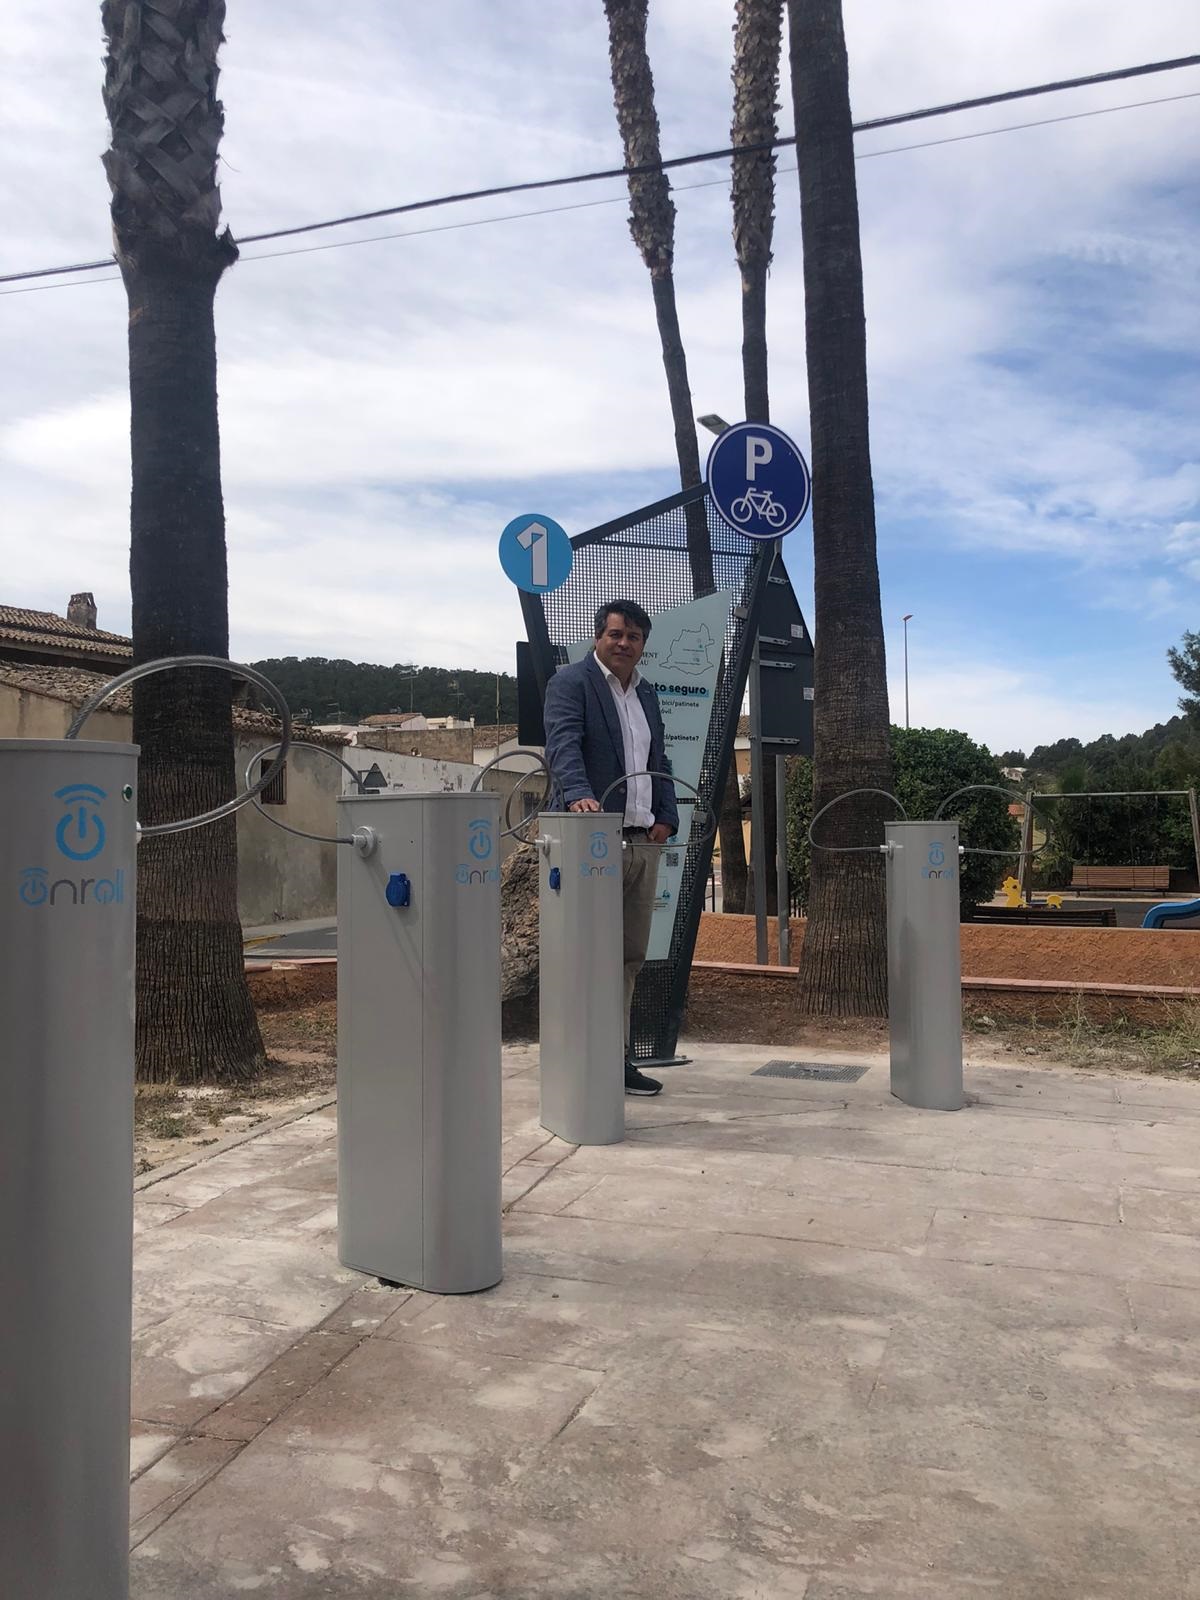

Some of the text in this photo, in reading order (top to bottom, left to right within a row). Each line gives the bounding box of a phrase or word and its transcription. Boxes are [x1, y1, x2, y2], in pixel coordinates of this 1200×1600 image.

[745, 436, 773, 481] P
[516, 521, 548, 586] 1
[668, 684, 707, 696] seguro
